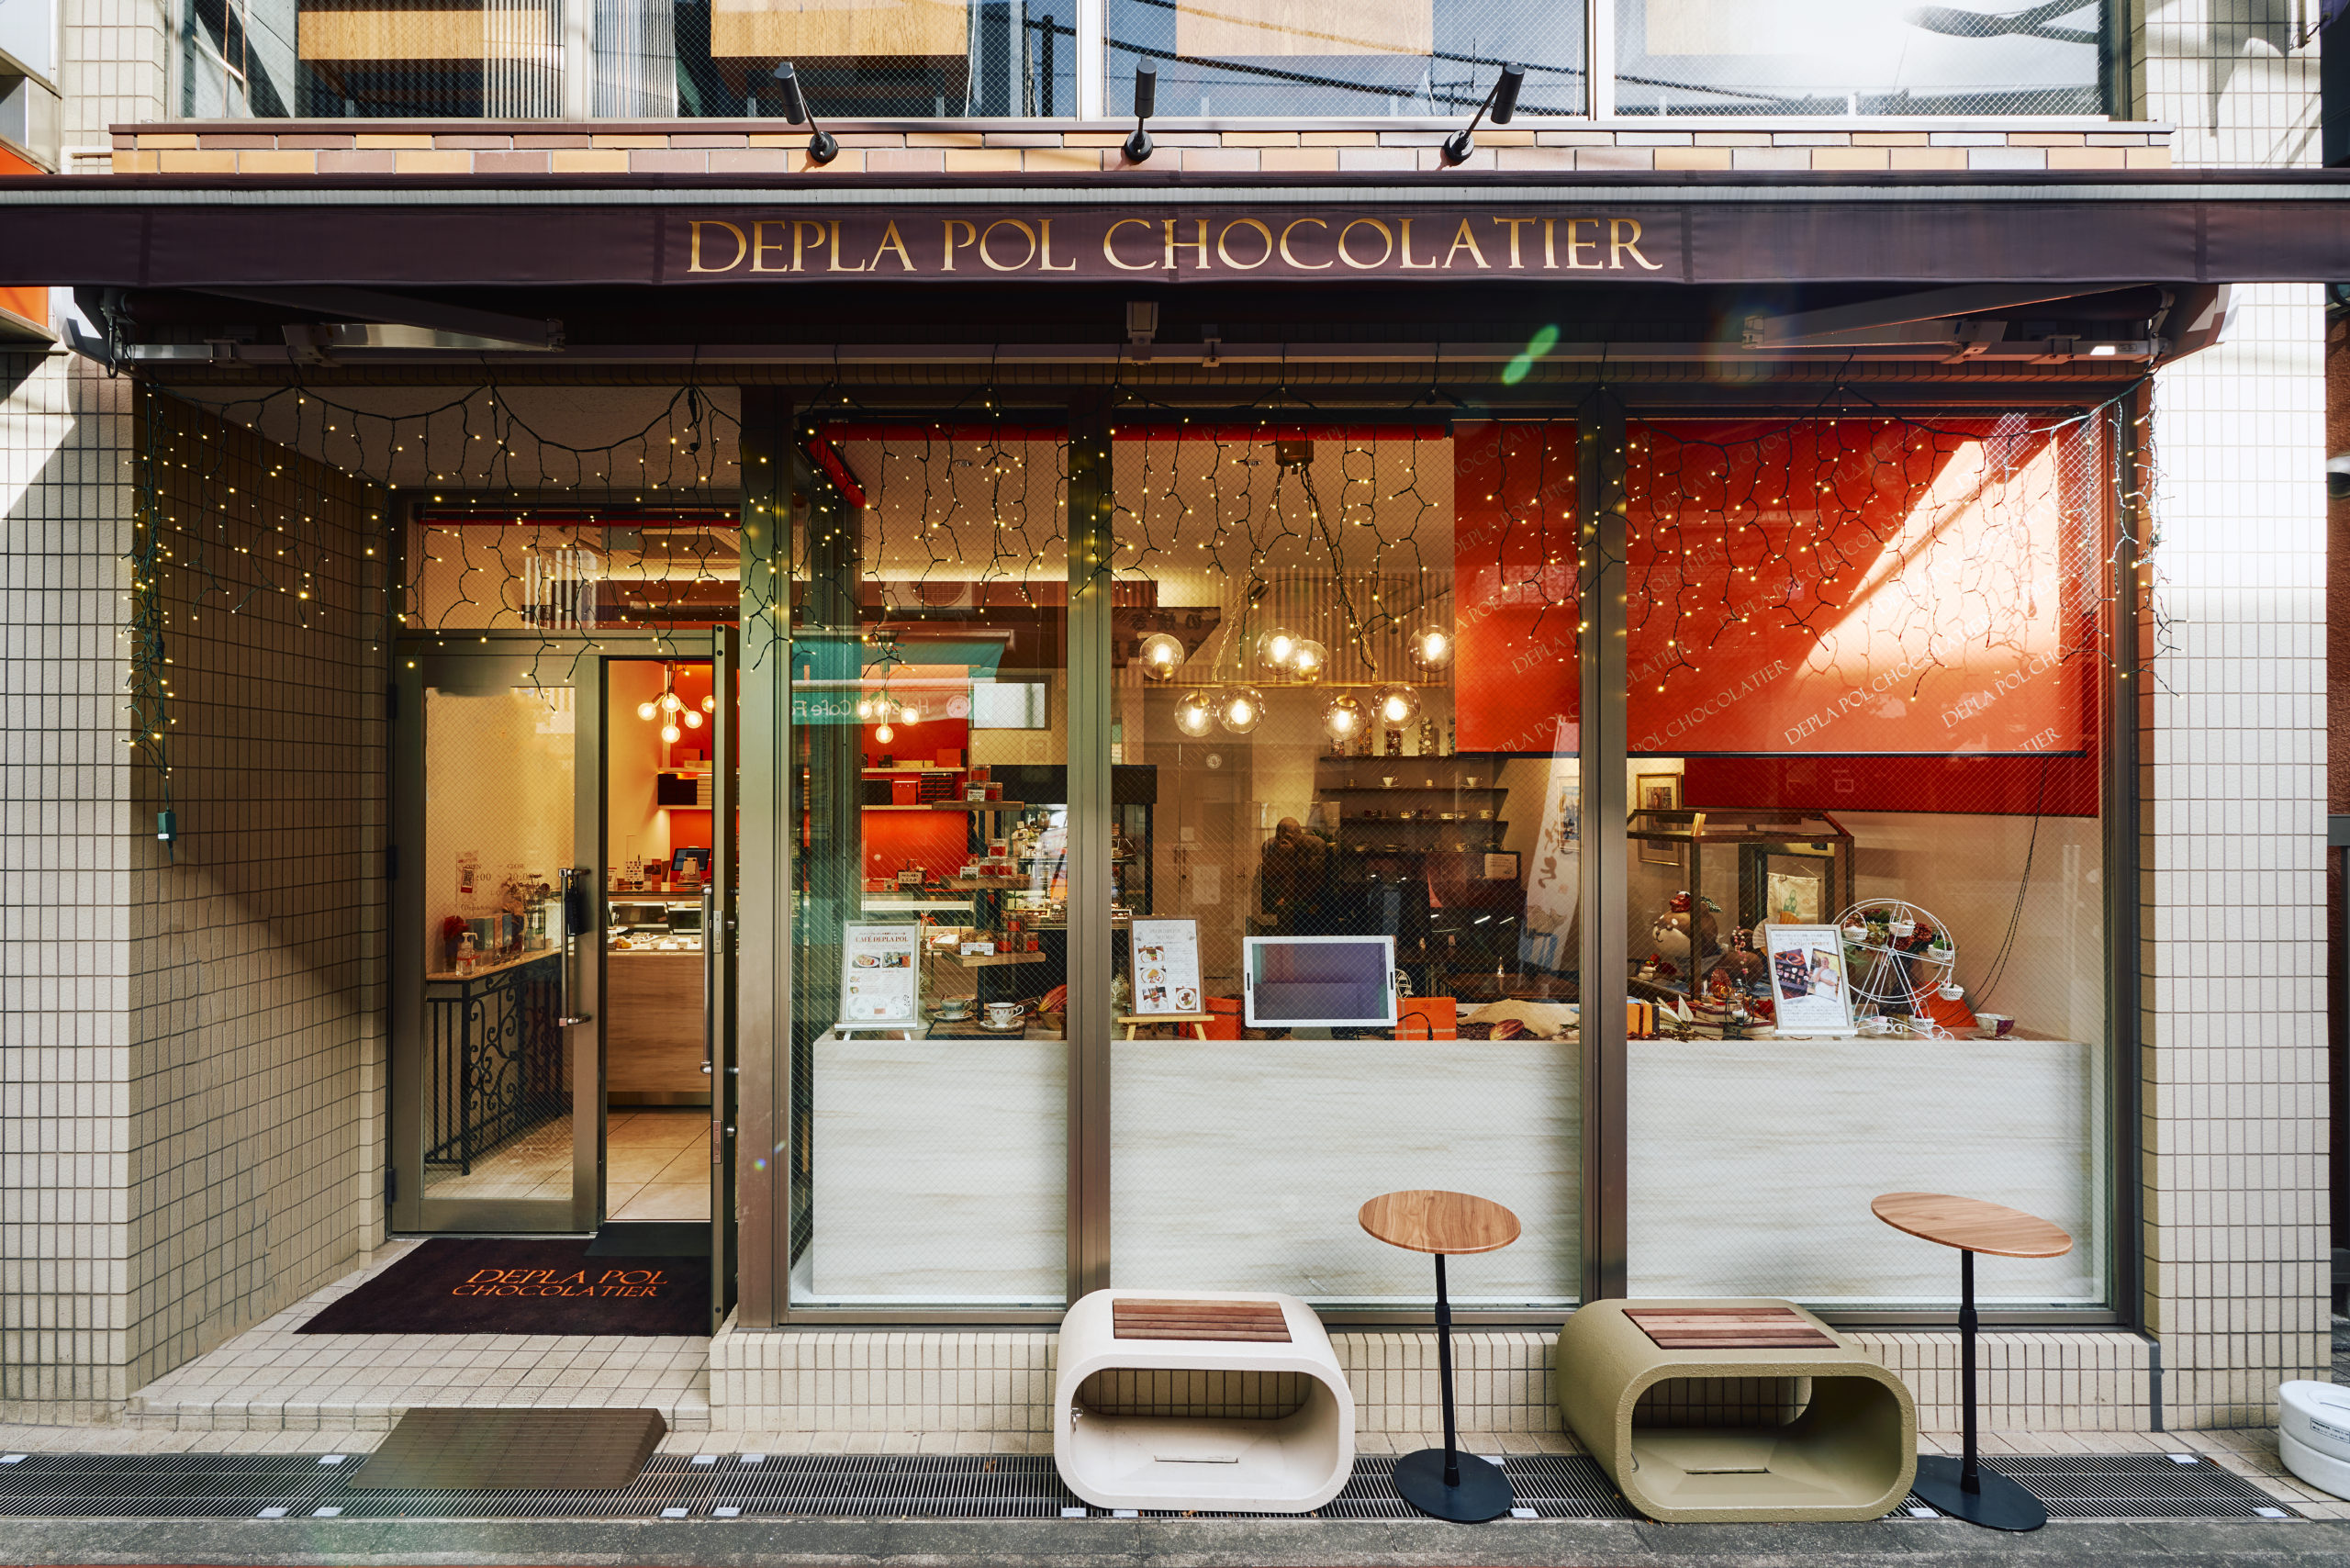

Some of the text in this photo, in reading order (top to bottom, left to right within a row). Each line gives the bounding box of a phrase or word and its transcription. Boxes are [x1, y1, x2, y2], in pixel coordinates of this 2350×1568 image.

[687, 218, 1663, 273] DEPLA POL CHOCOLATIER
[1512, 636, 1567, 675] DEPLA
[1631, 658, 1792, 753] POL CHOCOLATIER
[1784, 707, 1840, 745] DEPLA
[1839, 687, 1874, 714] POL
[1941, 689, 1996, 728] DEPLA
[1995, 668, 2031, 697] POL
[2013, 726, 2063, 751] TIER
[452, 1284, 658, 1297] CHOCOLATIER
[465, 1269, 669, 1285] DEPLA POL
